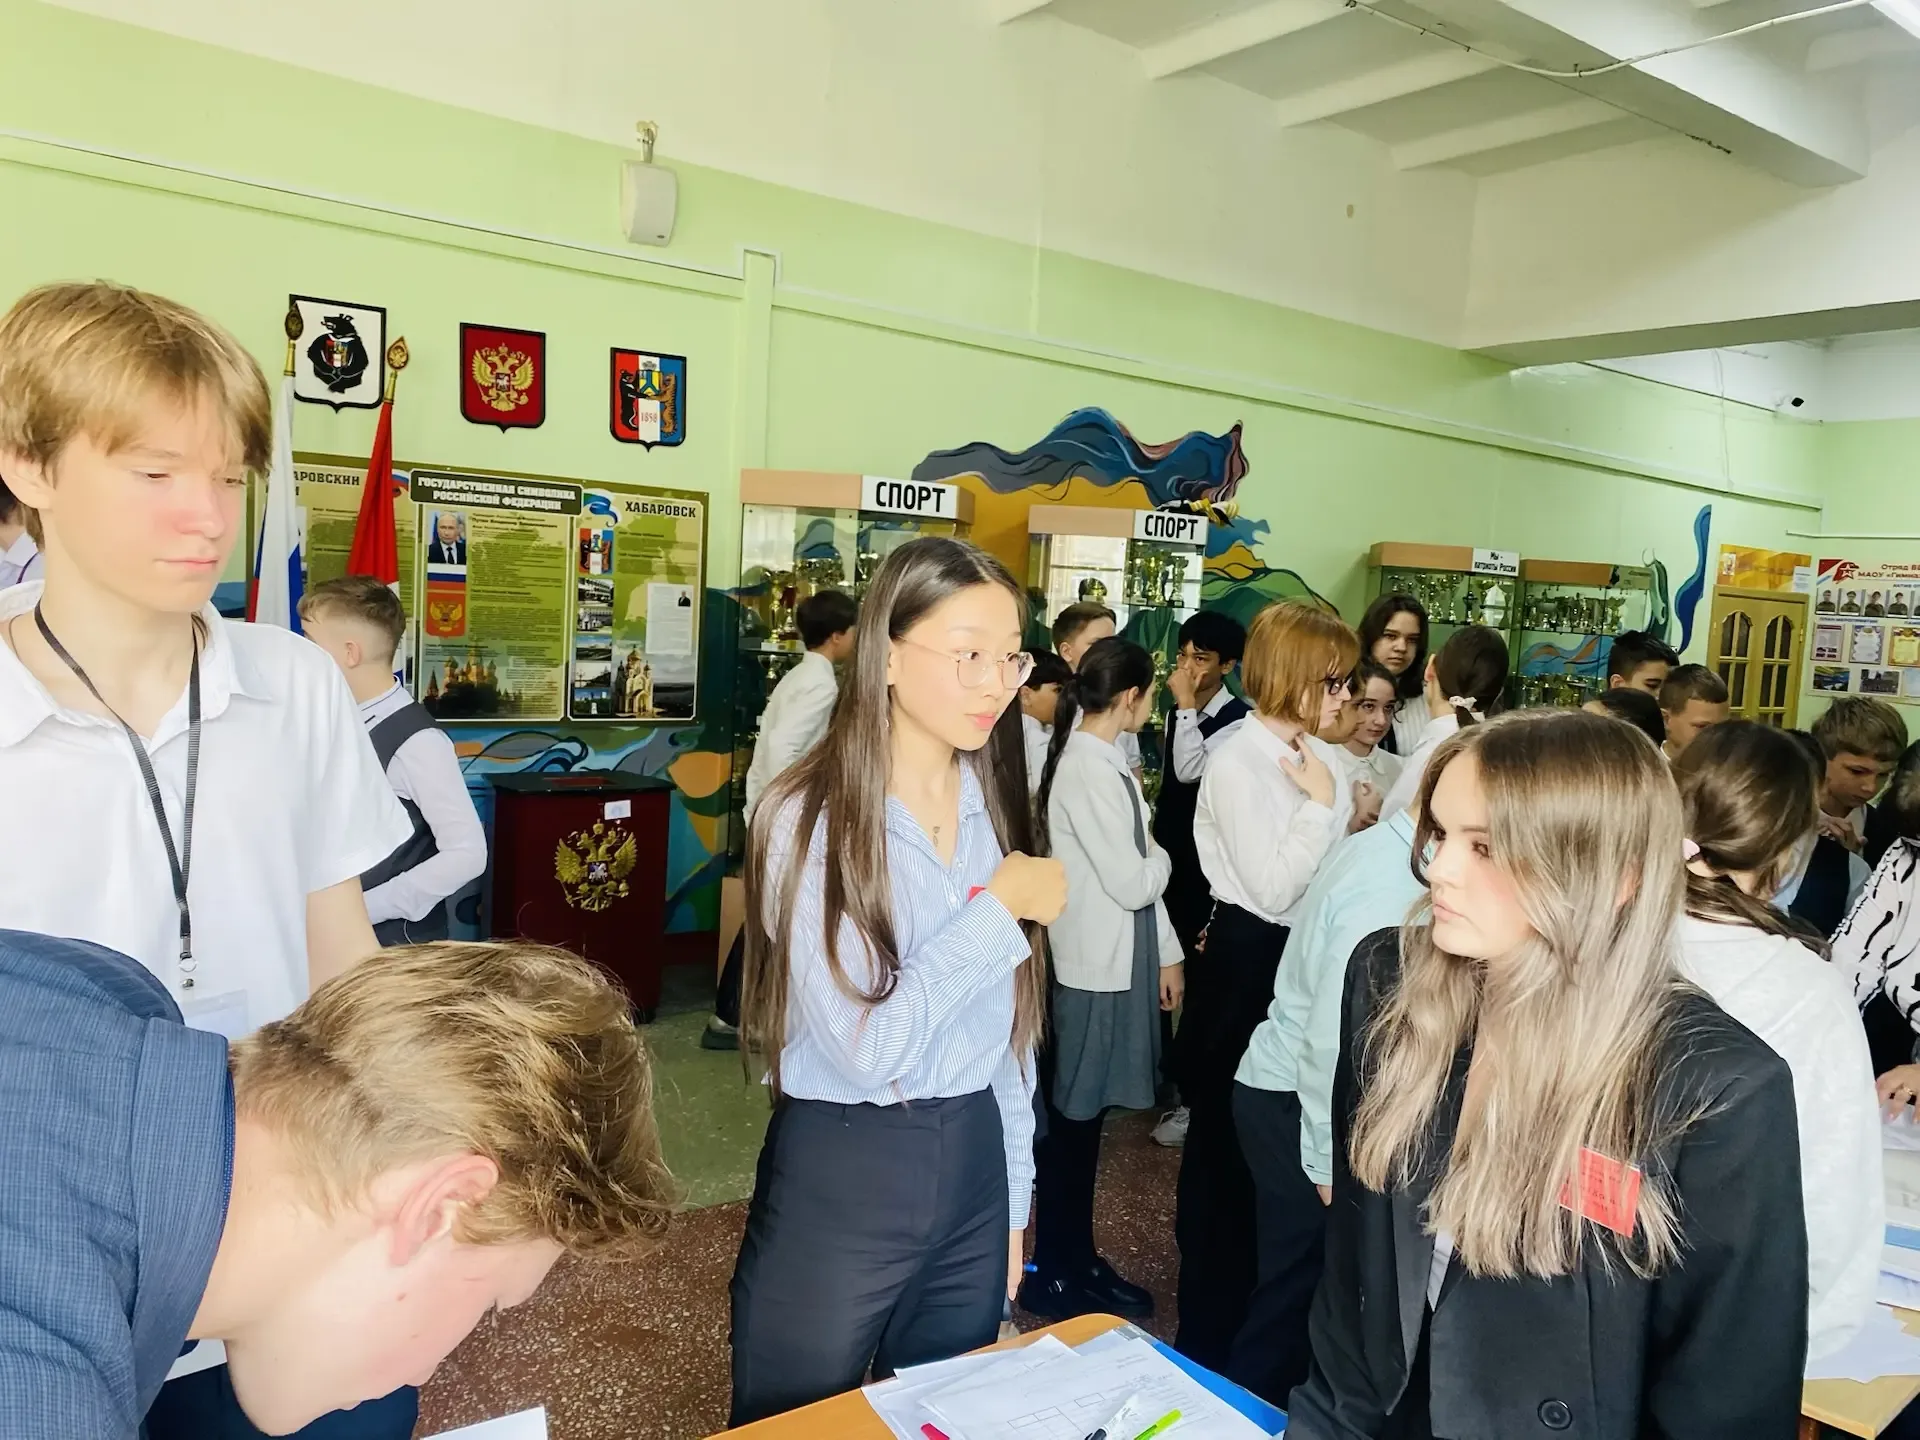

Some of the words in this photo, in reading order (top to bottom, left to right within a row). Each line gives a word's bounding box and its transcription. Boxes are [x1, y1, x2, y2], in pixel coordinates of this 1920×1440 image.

[293, 471, 360, 486] АРОВСКИЙ
[417, 476, 516, 495] ГОСУДАРСТВЕННАЯ
[517, 485, 576, 500] СИМВОЛИКА
[433, 490, 500, 505] РОССИЙСКОЙ
[502, 496, 562, 510] ФЕДЕРАЦИИ
[876, 481, 946, 513] СПОРТ
[625, 501, 696, 518] ХАБАРОВСК
[1144, 514, 1199, 540] СПОРТ
